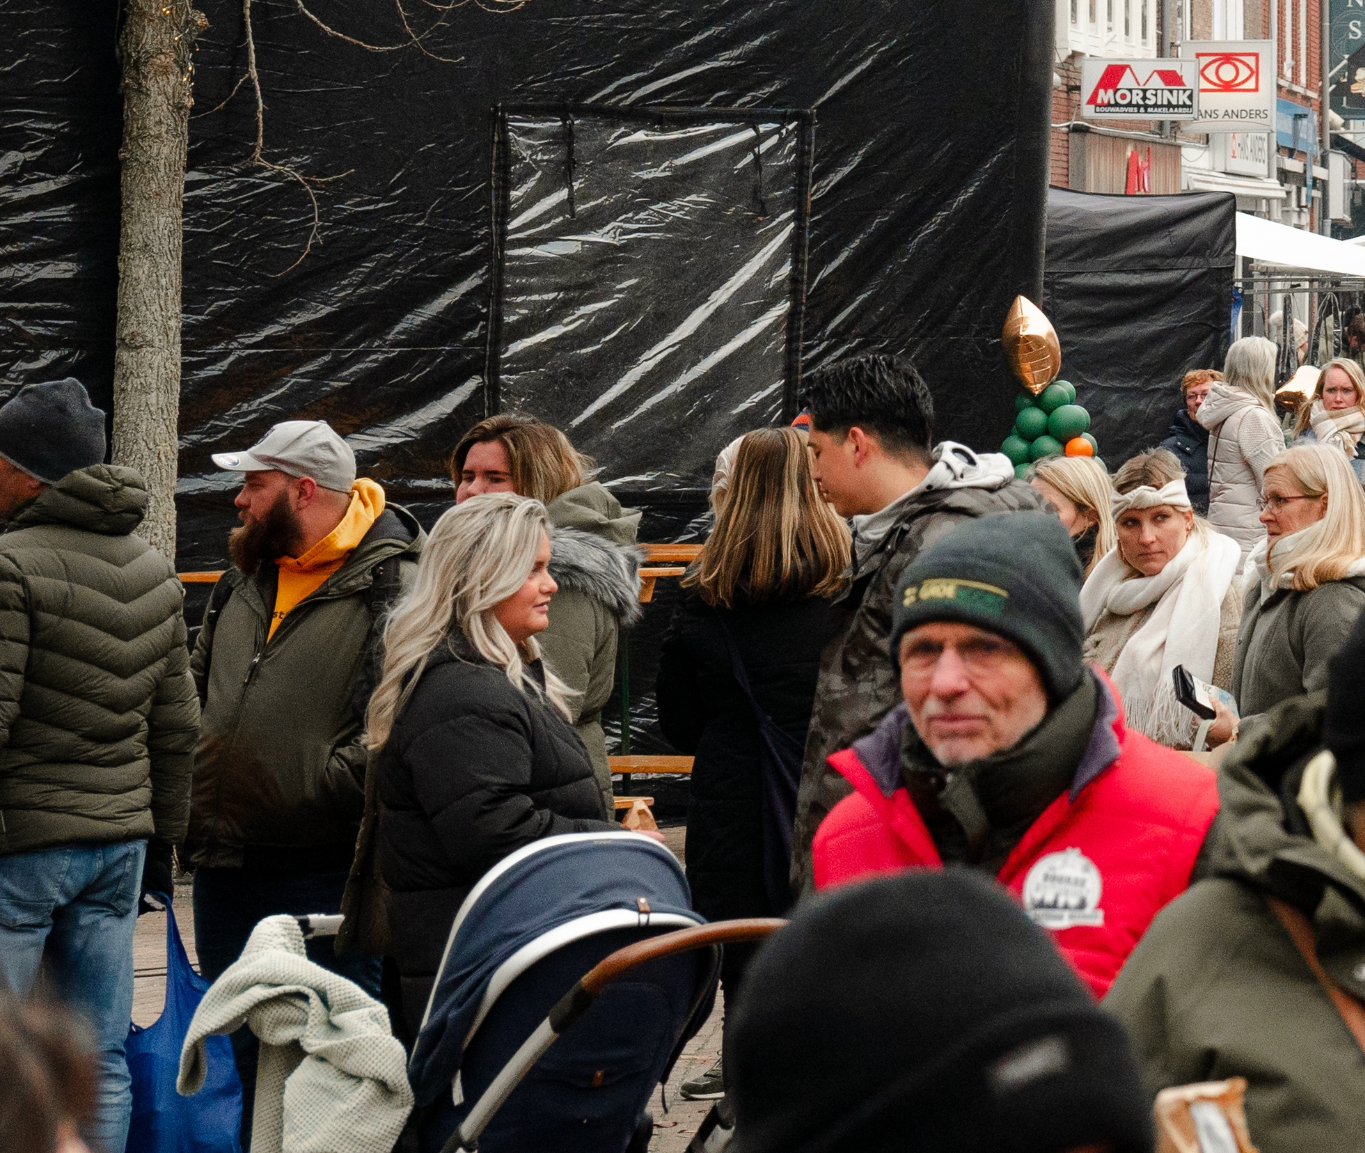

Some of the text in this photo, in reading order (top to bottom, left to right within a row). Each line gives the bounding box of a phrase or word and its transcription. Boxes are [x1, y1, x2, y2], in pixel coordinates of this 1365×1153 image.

[1096, 89, 1193, 105] MORSINK
[1198, 109, 1268, 119] ANS ANDERS
